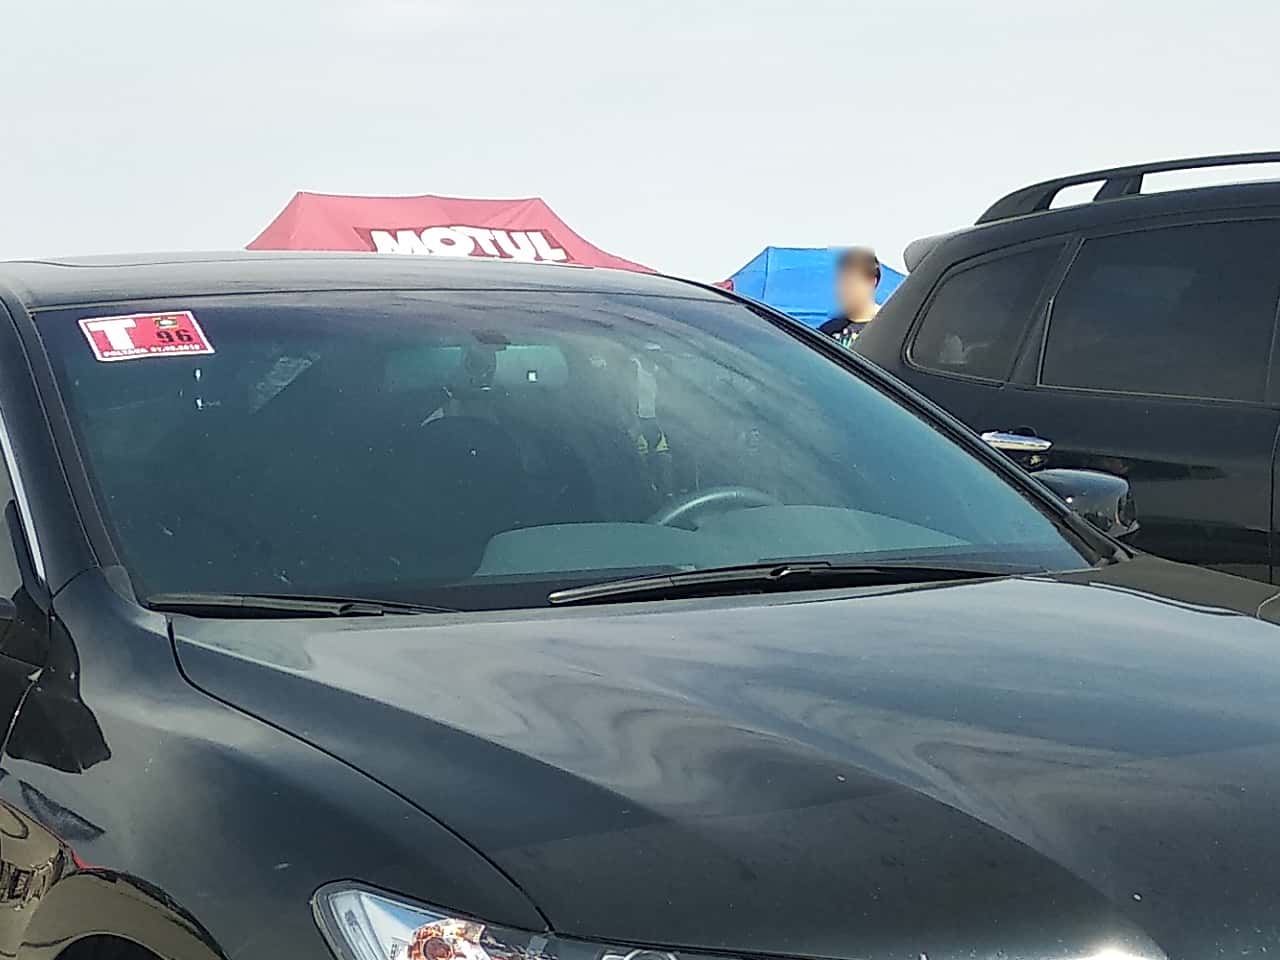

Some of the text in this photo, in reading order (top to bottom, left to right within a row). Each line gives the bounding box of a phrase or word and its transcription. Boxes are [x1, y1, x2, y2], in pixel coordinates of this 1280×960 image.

[369, 225, 569, 263] MOTUL
[86, 318, 137, 350] T
[156, 328, 194, 344] 96
